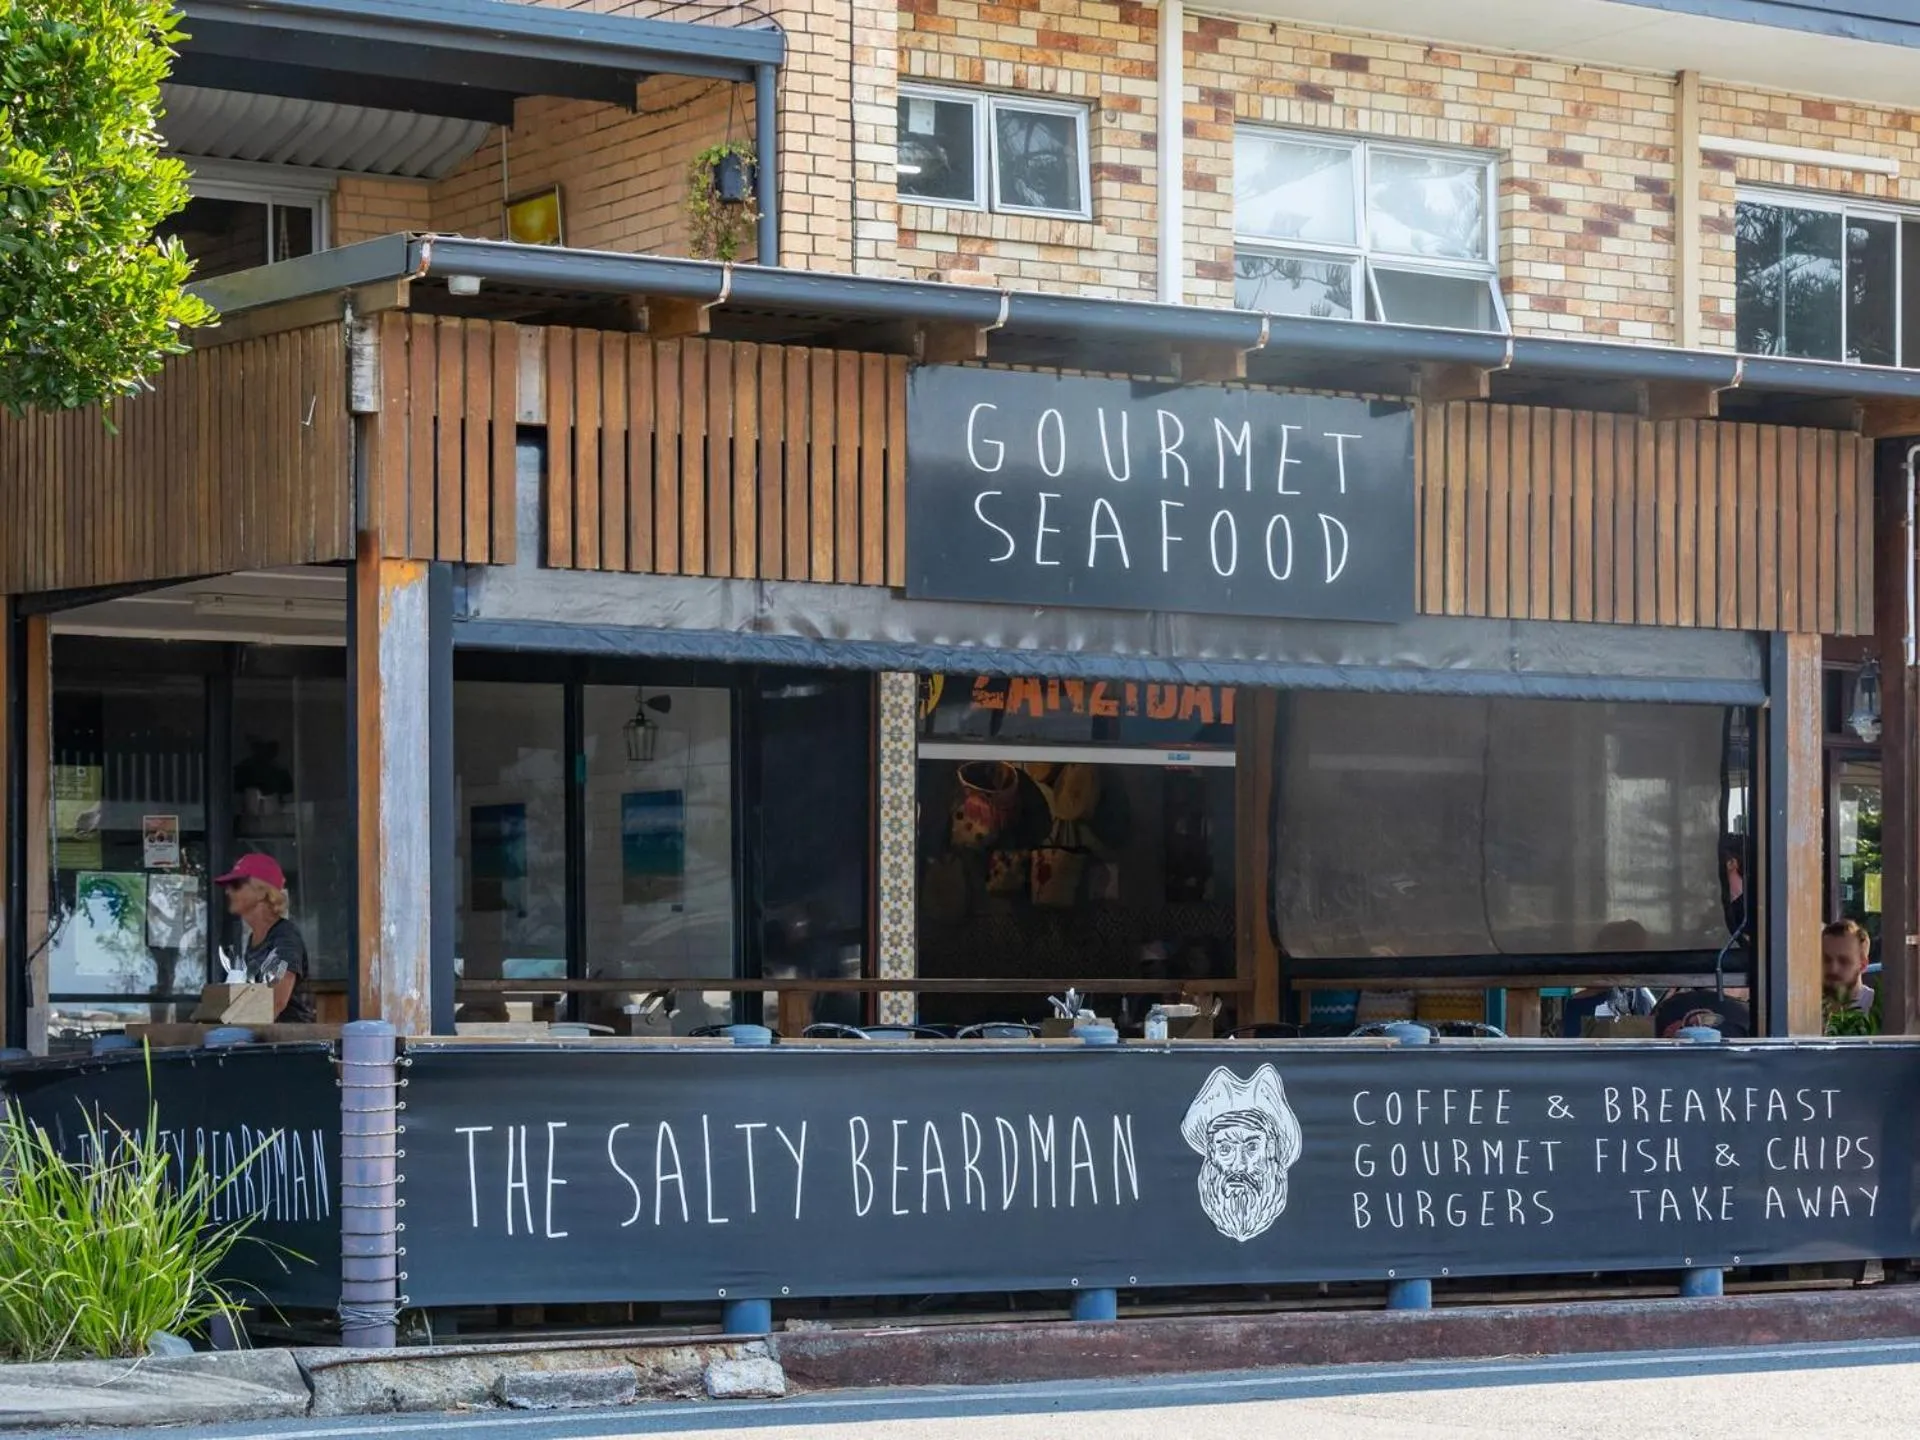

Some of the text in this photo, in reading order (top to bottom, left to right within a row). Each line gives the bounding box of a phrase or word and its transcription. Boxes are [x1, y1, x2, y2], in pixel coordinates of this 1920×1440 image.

[966, 402, 1363, 495] GOURMET
[973, 491, 1349, 584] SEAFOOD
[1353, 1086, 1841, 1126] COFFEE & BREAKFAST
[454, 1111, 1139, 1238] THE SALTY BEARDMAN
[1354, 1135, 1876, 1178] GOURMET FISH & CHIPS
[1353, 1184, 1880, 1229] BURGERS TAKE AWAY
